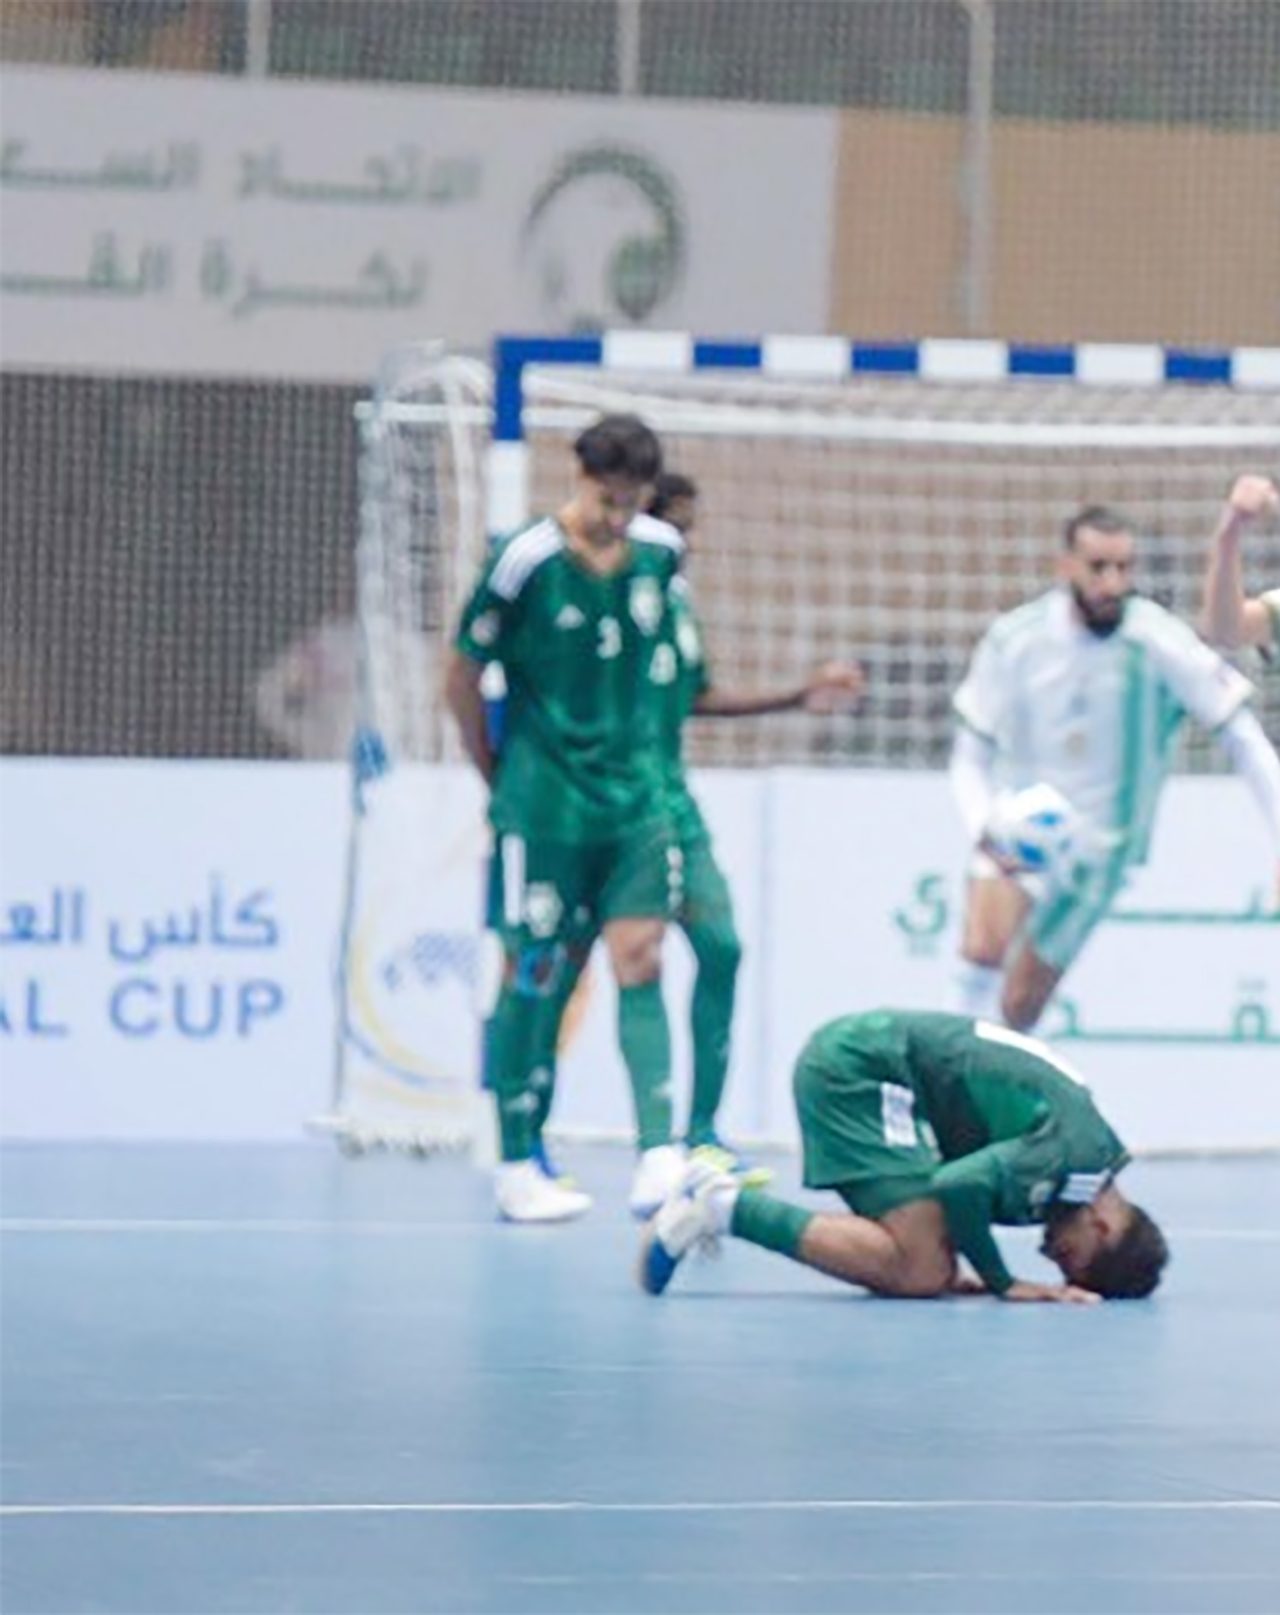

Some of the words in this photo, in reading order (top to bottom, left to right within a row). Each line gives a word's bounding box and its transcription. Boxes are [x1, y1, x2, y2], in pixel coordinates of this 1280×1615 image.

[107, 871, 279, 962] كأس
[0, 978, 68, 1035] L
[108, 977, 285, 1038] CUP
